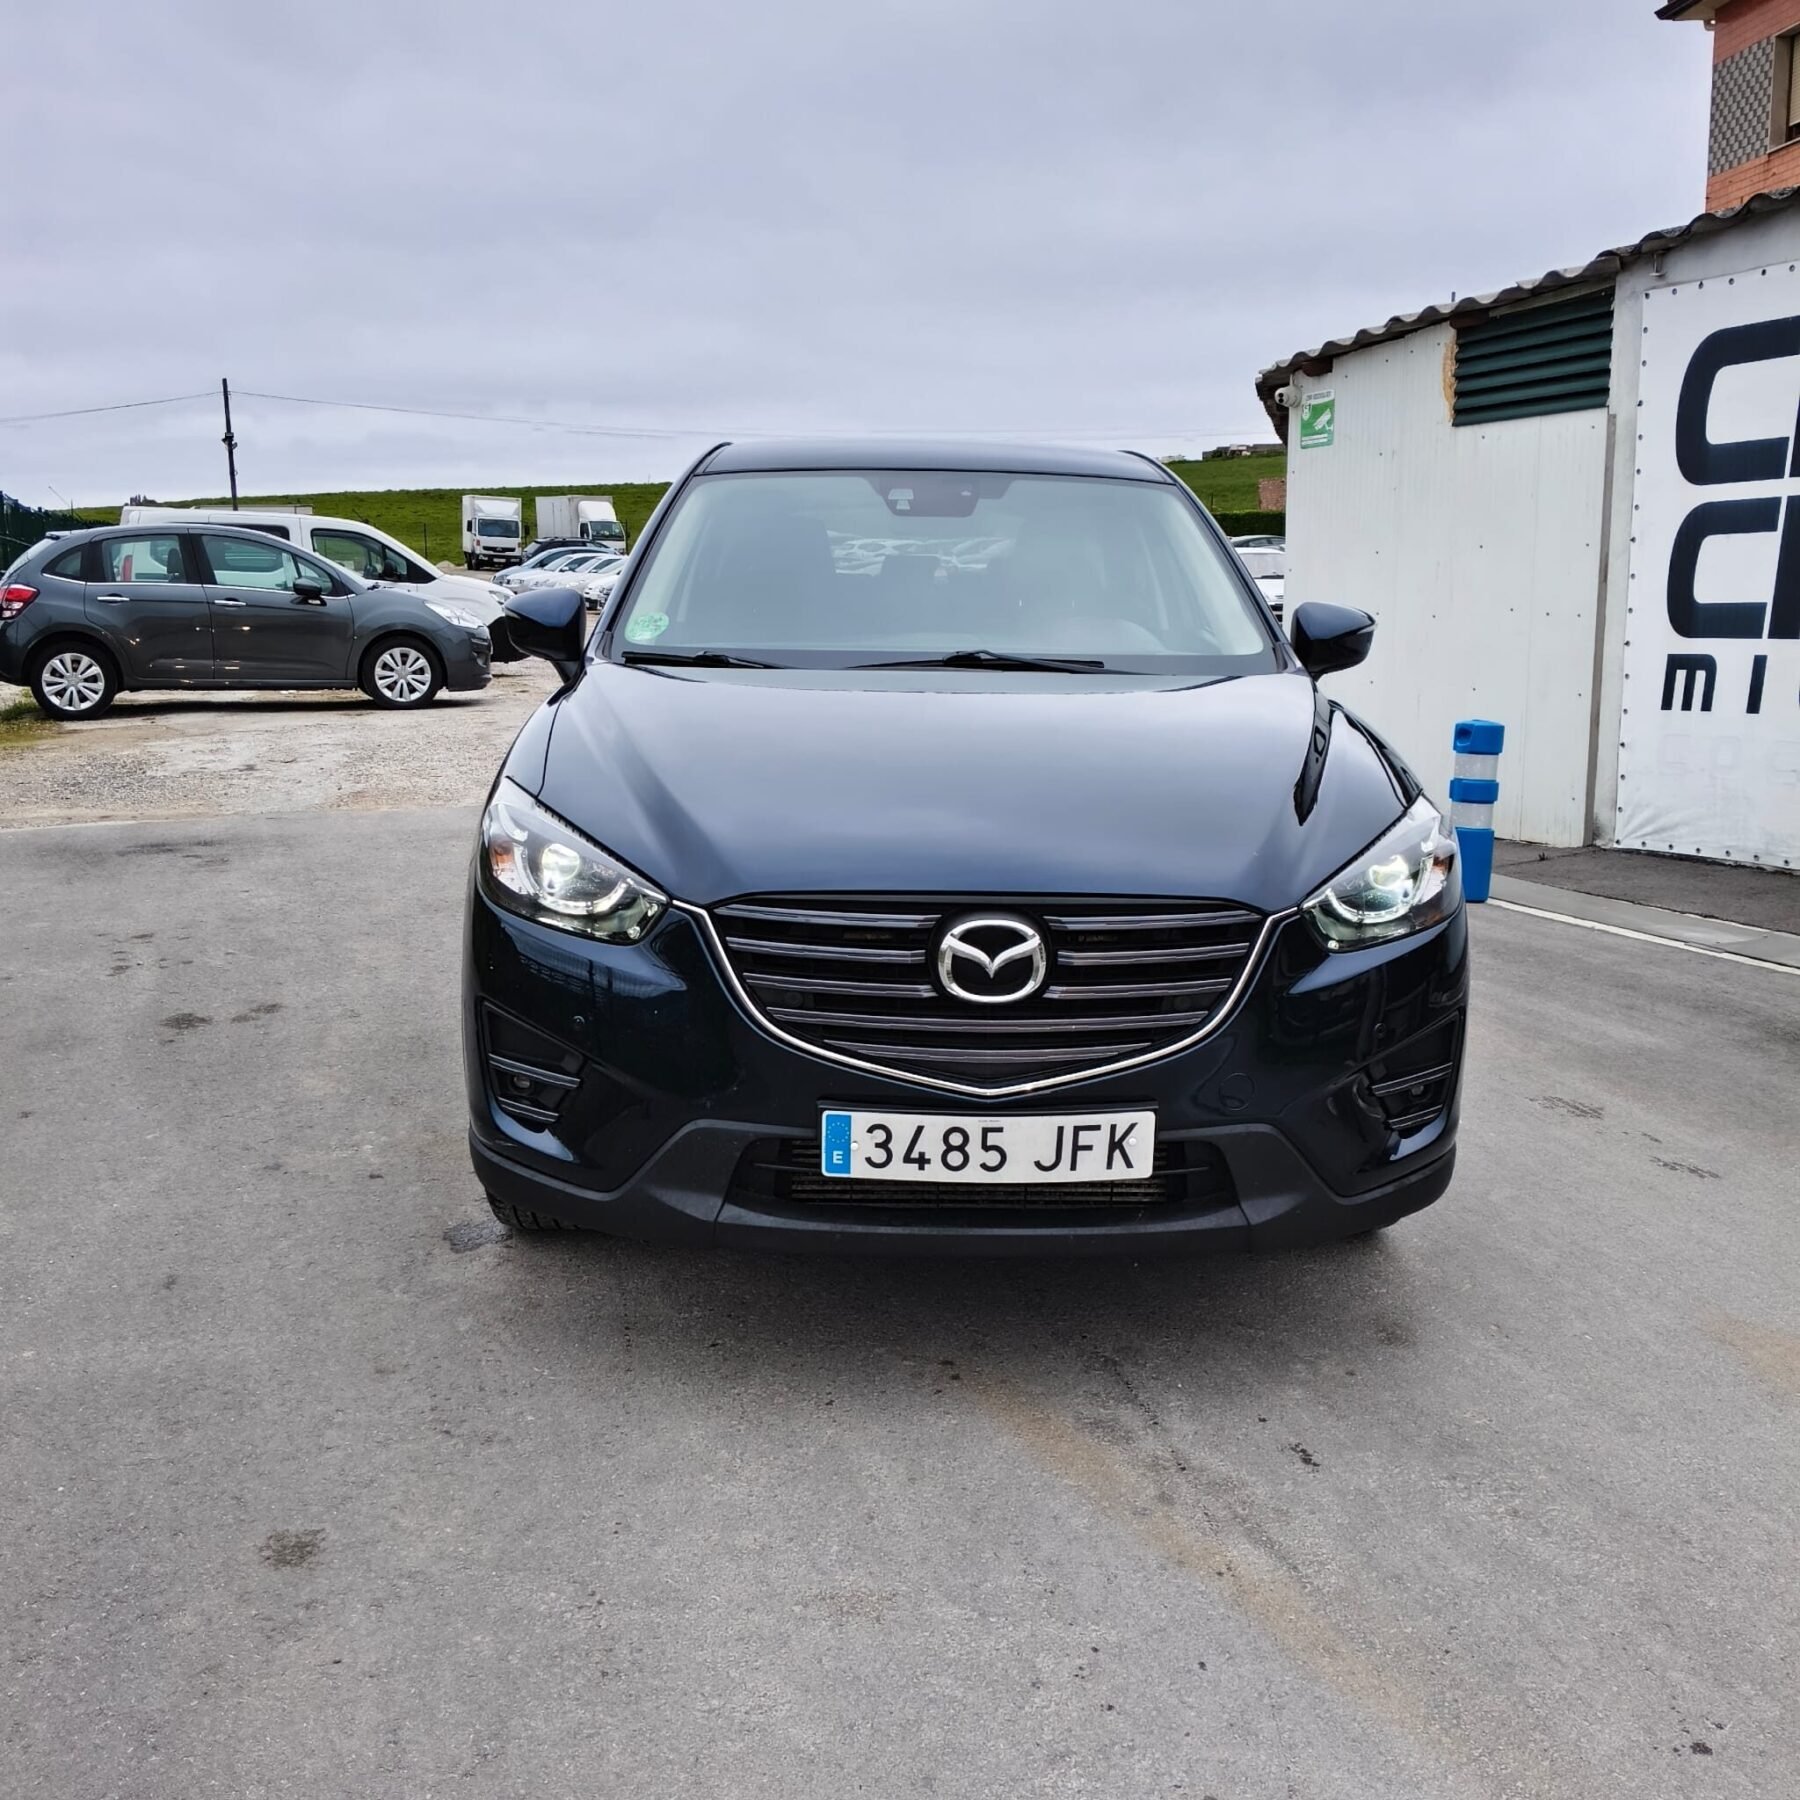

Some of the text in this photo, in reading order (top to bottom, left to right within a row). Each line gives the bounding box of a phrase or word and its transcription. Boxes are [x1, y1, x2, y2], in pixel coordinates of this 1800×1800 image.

[1660, 653, 1800, 715] MI
[832, 1150, 844, 1165] E
[864, 1121, 1139, 1173] 3485 JFK
